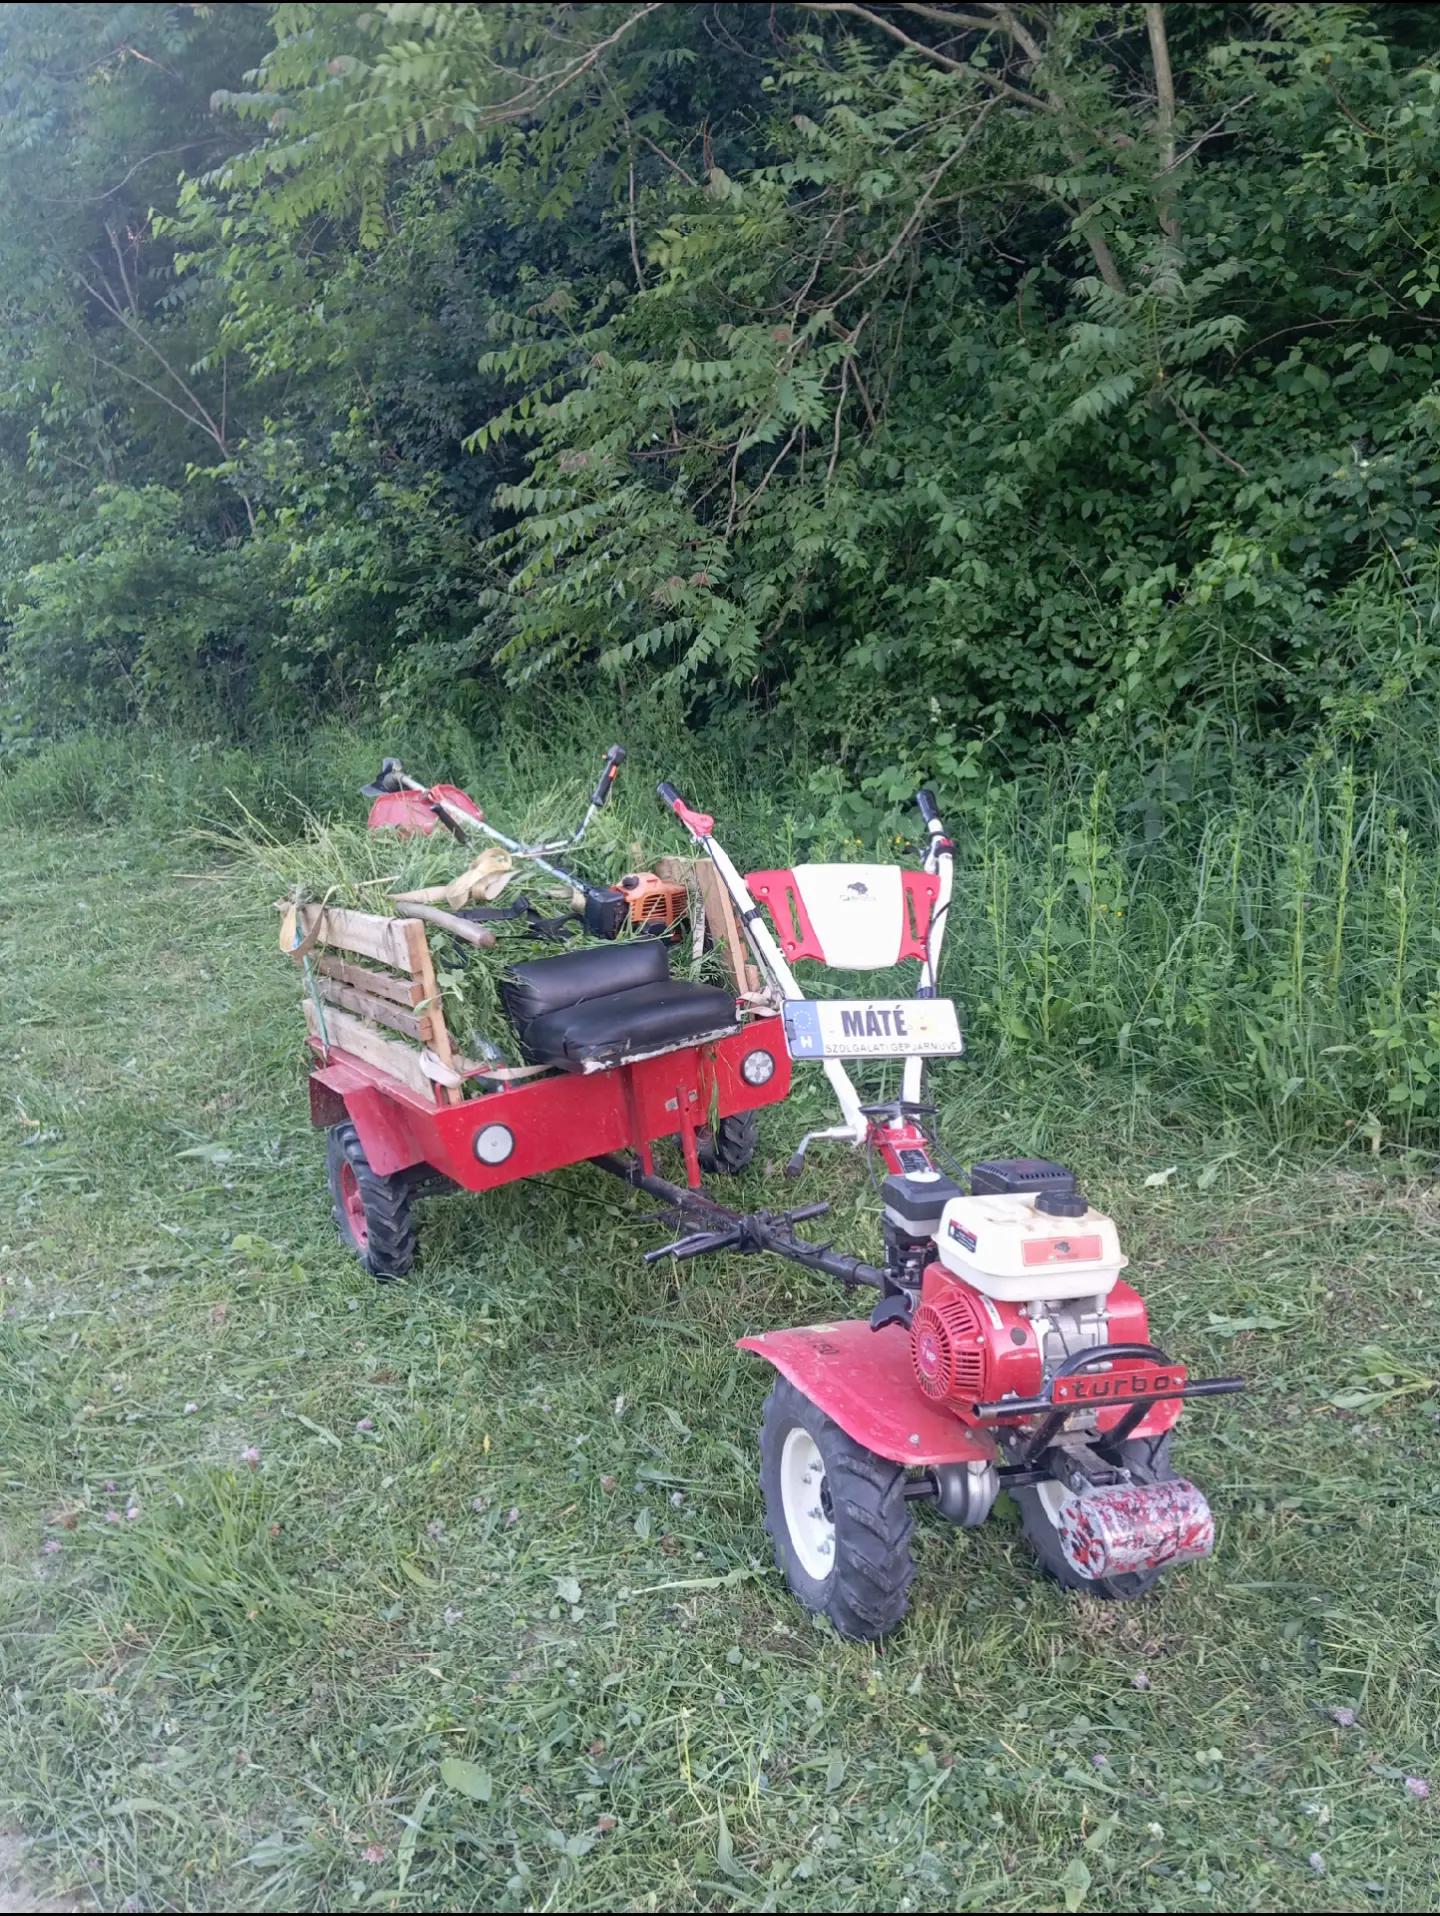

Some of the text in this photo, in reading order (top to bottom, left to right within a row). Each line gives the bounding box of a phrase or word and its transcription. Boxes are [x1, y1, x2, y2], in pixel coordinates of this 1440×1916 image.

[841, 1005, 908, 1037] MÁTÉ
[800, 1034, 813, 1049] H
[1072, 1375, 1170, 1398] turbo
